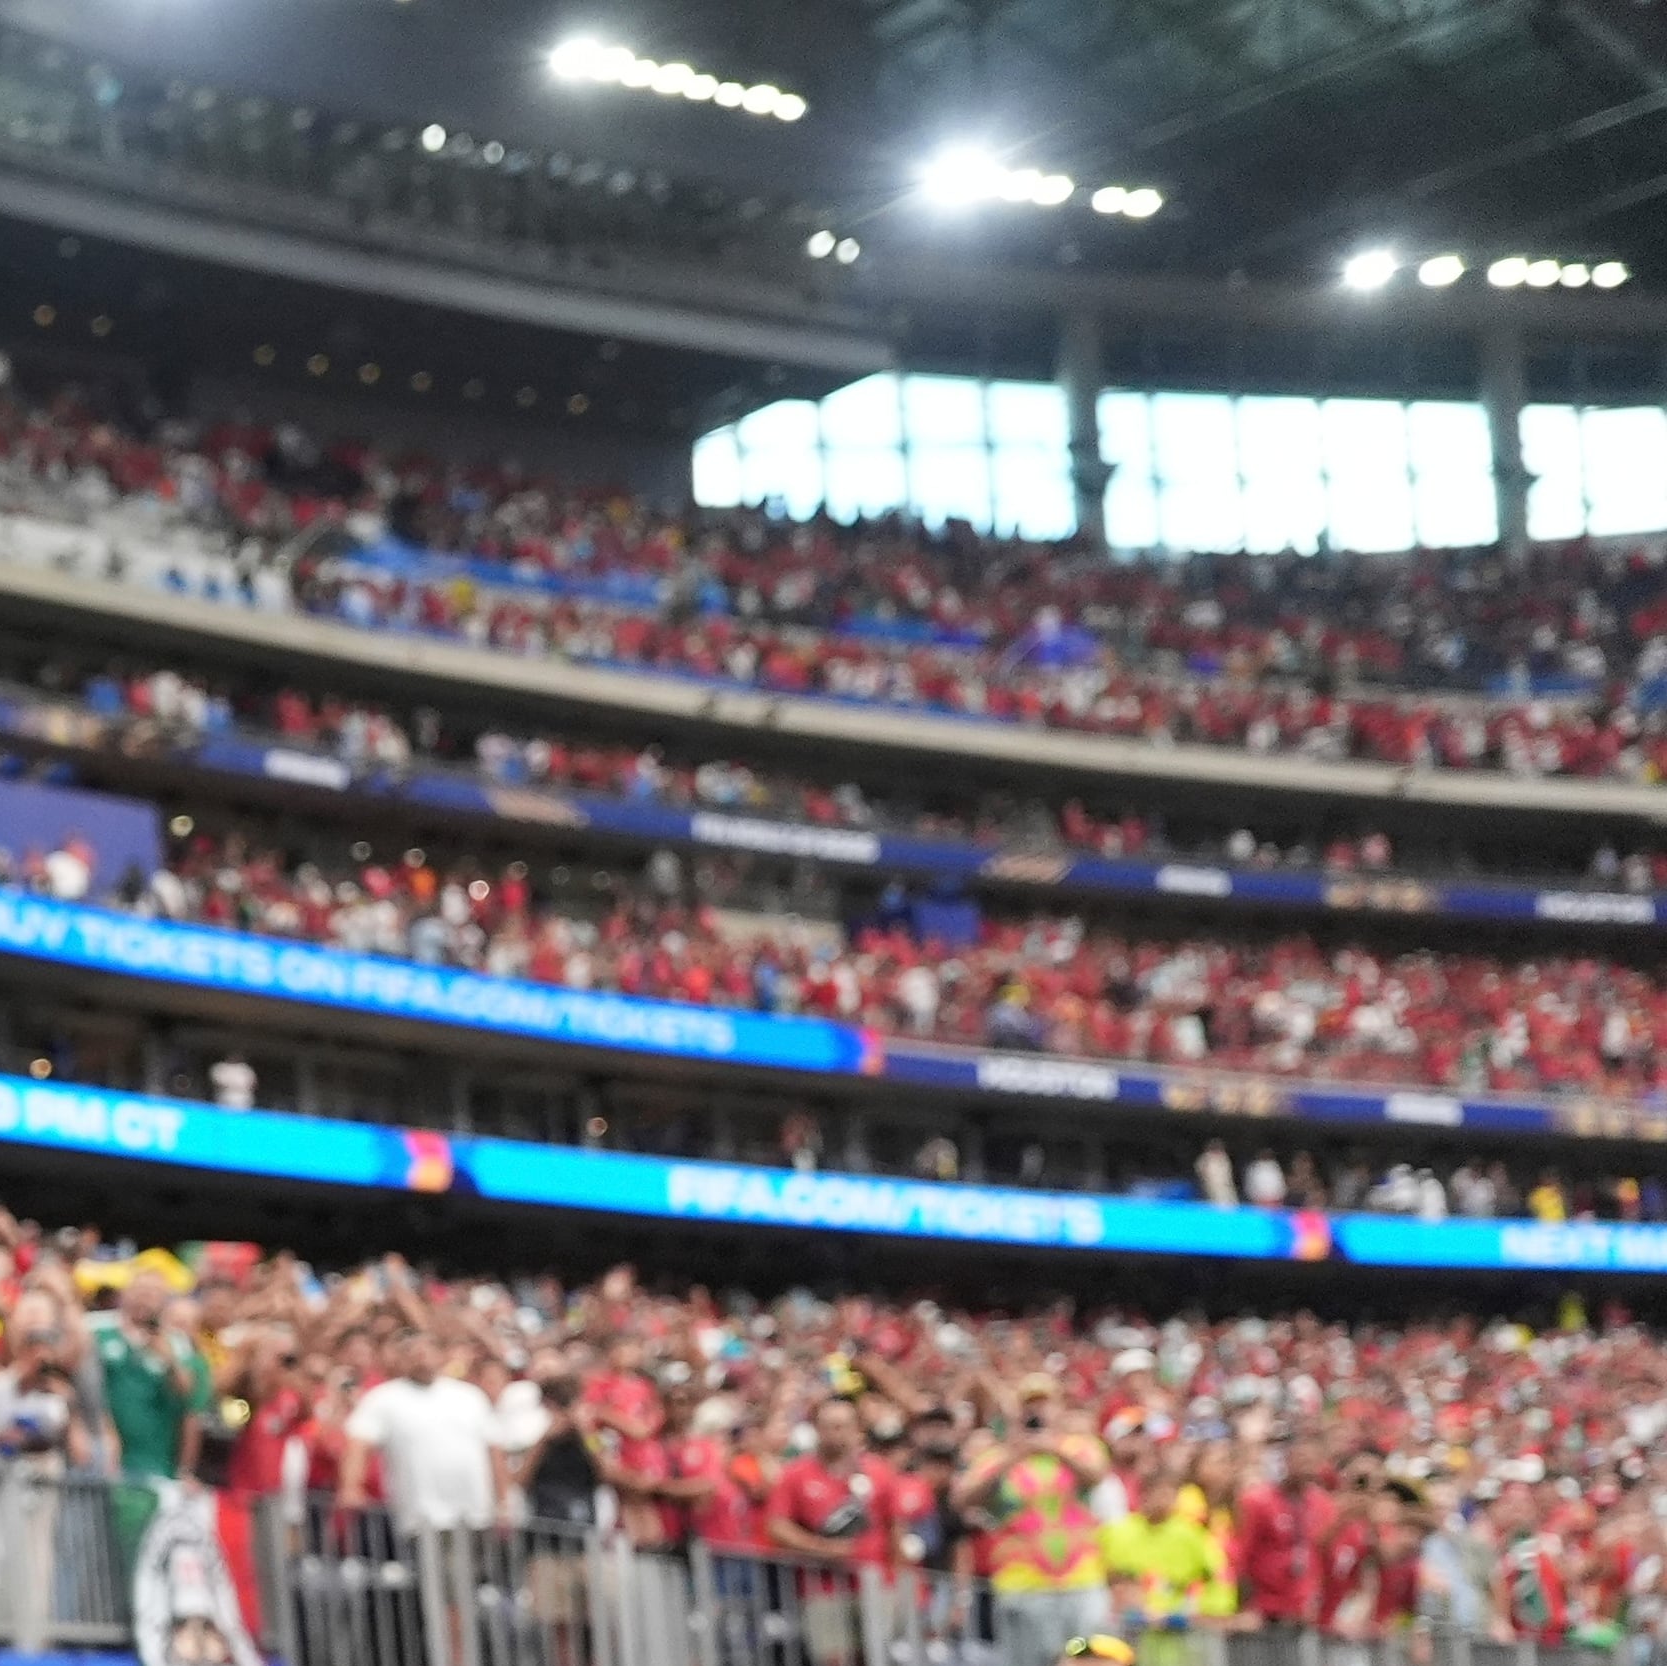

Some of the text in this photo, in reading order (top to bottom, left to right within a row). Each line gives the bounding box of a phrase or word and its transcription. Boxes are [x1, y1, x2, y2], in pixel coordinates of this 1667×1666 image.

[78, 914, 272, 984] TICKETS
[25, 1089, 109, 1143] PM
[116, 1103, 185, 1149] CT
